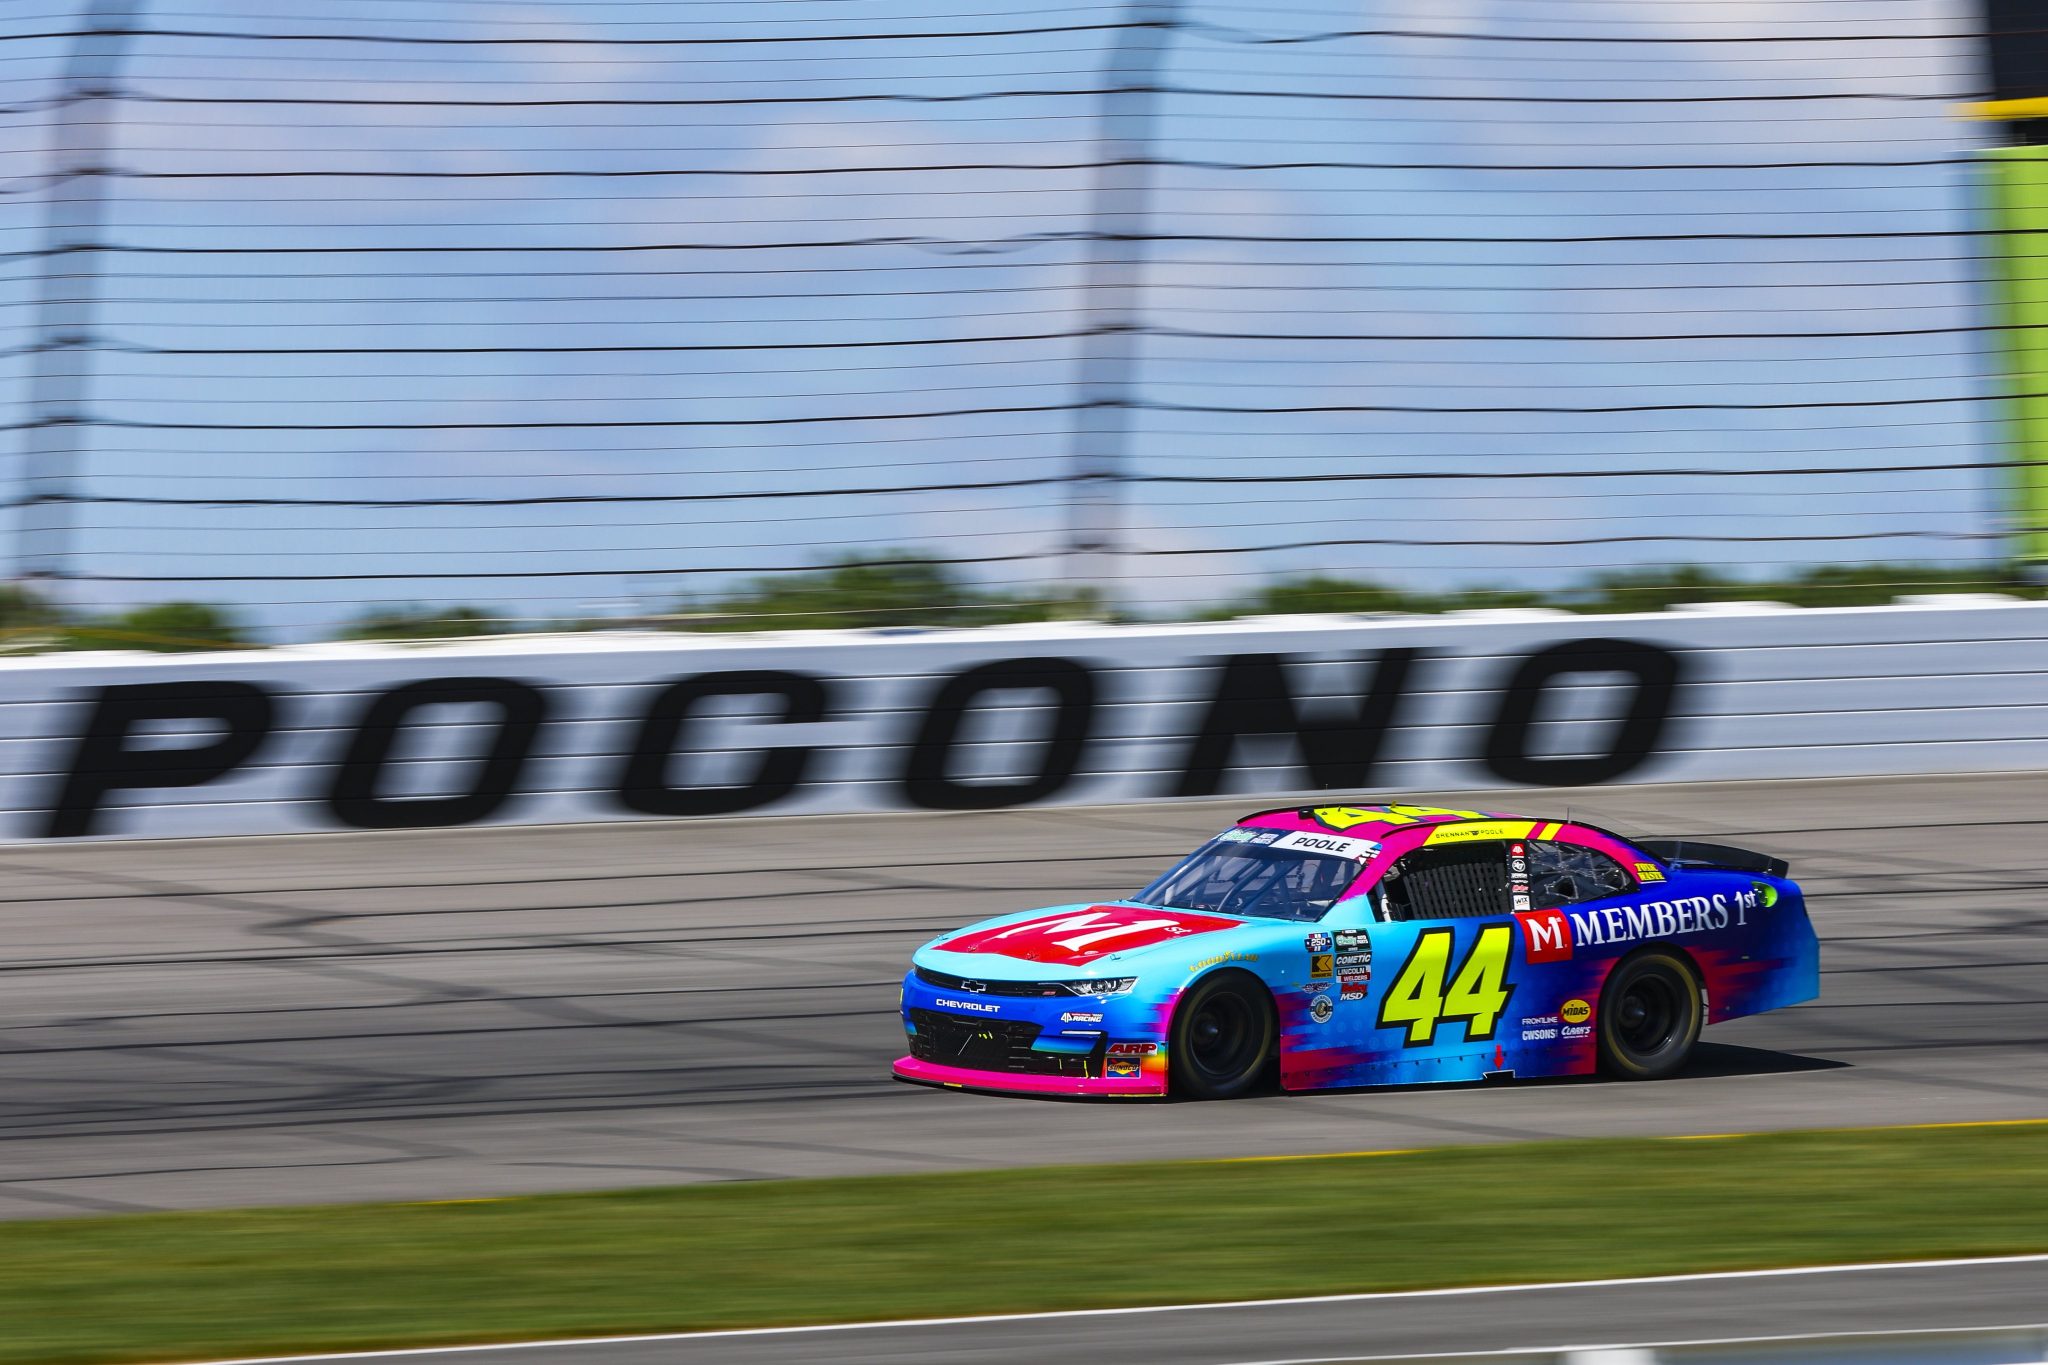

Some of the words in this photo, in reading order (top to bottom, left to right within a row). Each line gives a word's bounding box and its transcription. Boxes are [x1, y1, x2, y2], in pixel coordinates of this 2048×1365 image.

[42, 637, 1688, 838] POCONO
[1435, 831, 1470, 839] BRENNAN
[1291, 836, 1352, 853] POOLE
[1570, 893, 1729, 947] MEMBERS
[1734, 888, 1758, 927] 1st
[1336, 954, 1371, 965] COMETIC
[1338, 968, 1365, 976] LINCOLN
[1344, 974, 1368, 982] WELDERS
[1376, 922, 1517, 1049] 44
[1340, 993, 1364, 1001] MSD
[936, 998, 1000, 1012] CHEVROLET
[1562, 1006, 1589, 1016] MIDAS
[1073, 1015, 1103, 1023] RACING
[1522, 1016, 1558, 1025] FRONTLINE
[1522, 1029, 1556, 1041] CWSONS
[1106, 1043, 1158, 1056] ARP
